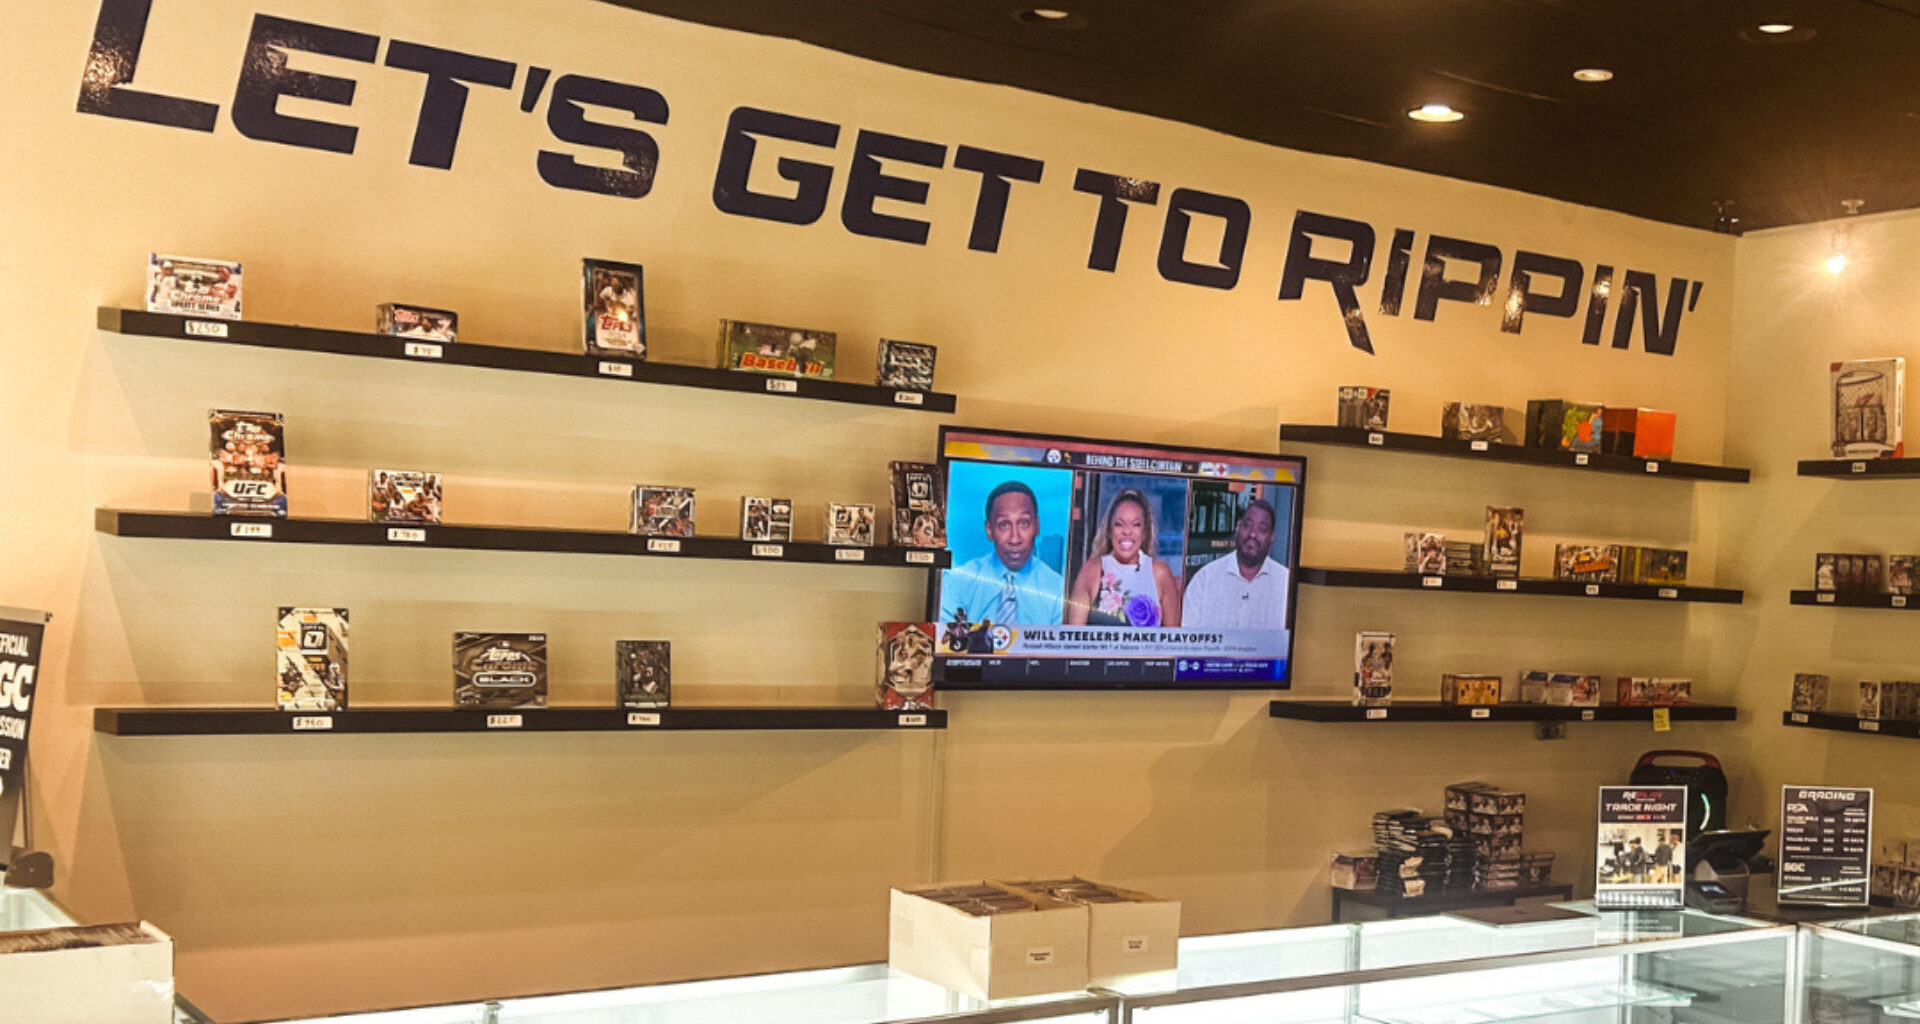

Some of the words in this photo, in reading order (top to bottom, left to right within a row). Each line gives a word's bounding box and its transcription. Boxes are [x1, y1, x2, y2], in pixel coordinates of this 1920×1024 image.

[76, 0, 670, 200] LET'S
[712, 106, 1045, 254] GET
[1073, 167, 1252, 291] TO
[1278, 210, 1704, 357] RIPPIN'
[740, 351, 823, 376] Basebll
[233, 482, 268, 496] UFC
[1023, 631, 1056, 642] WILL
[1059, 631, 1119, 643] STEELERS
[1123, 632, 1157, 643] MAKE
[1798, 791, 1856, 801] GRADING
[1605, 803, 1643, 812] TRADE
[1643, 803, 1678, 812] NIGHT
